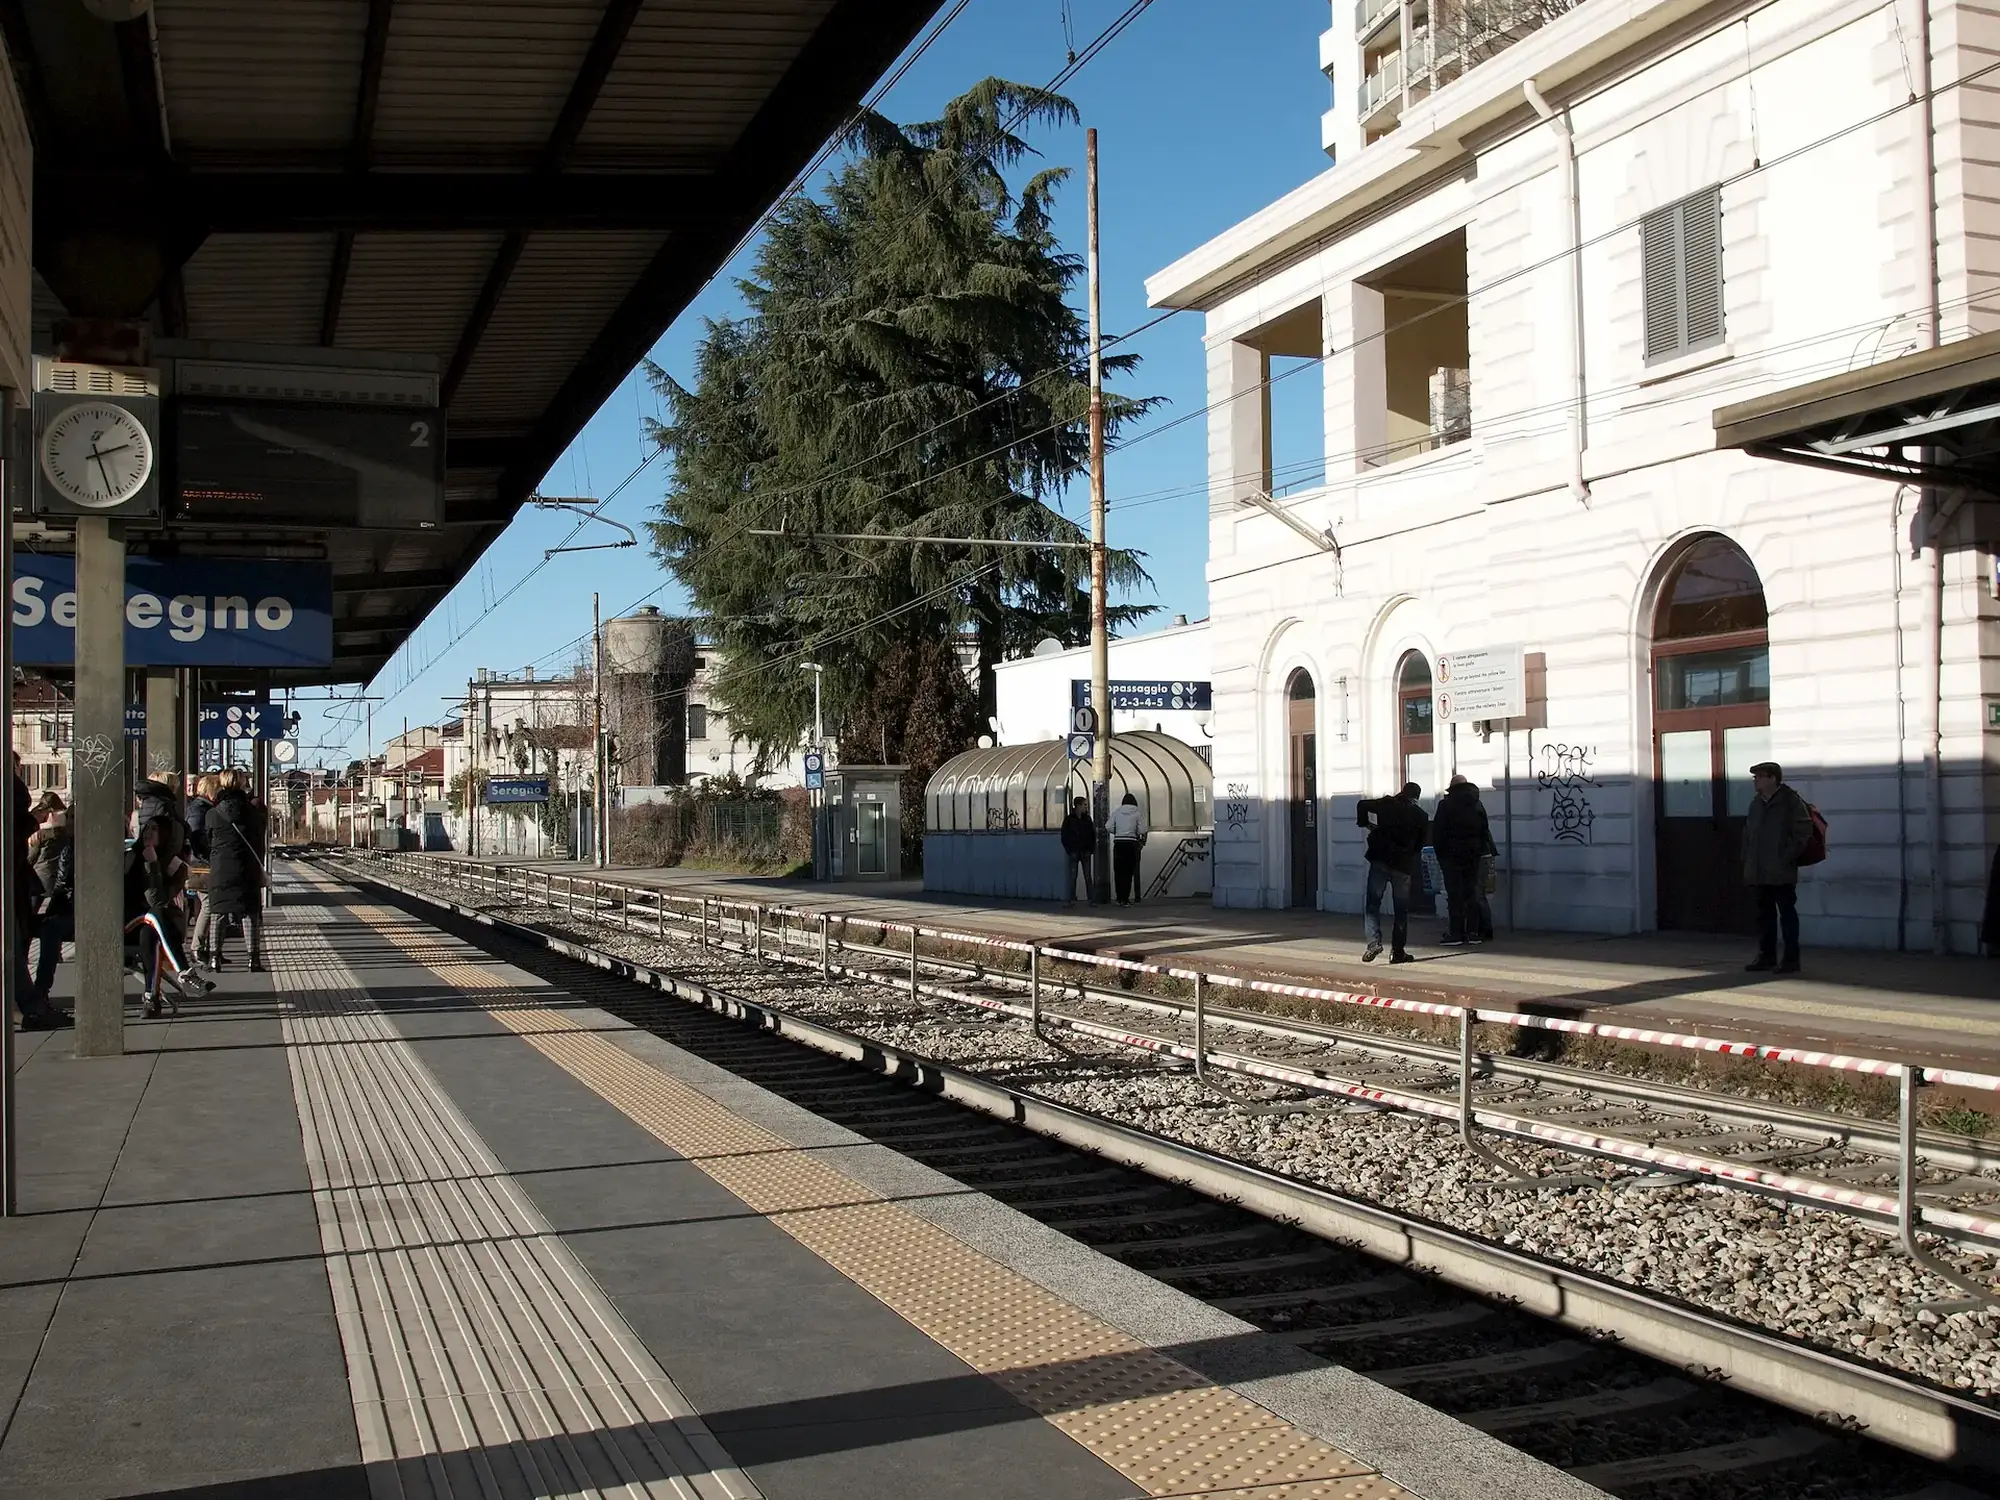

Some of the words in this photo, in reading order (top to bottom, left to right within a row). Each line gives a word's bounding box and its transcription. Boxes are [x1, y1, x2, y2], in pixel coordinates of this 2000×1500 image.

[410, 422, 429, 447] 2
[12, 576, 293, 642] Seegno
[1120, 697, 1163, 707] 2-3-4-5
[1081, 712, 1087, 727] 1
[491, 785, 541, 797] Seregno
